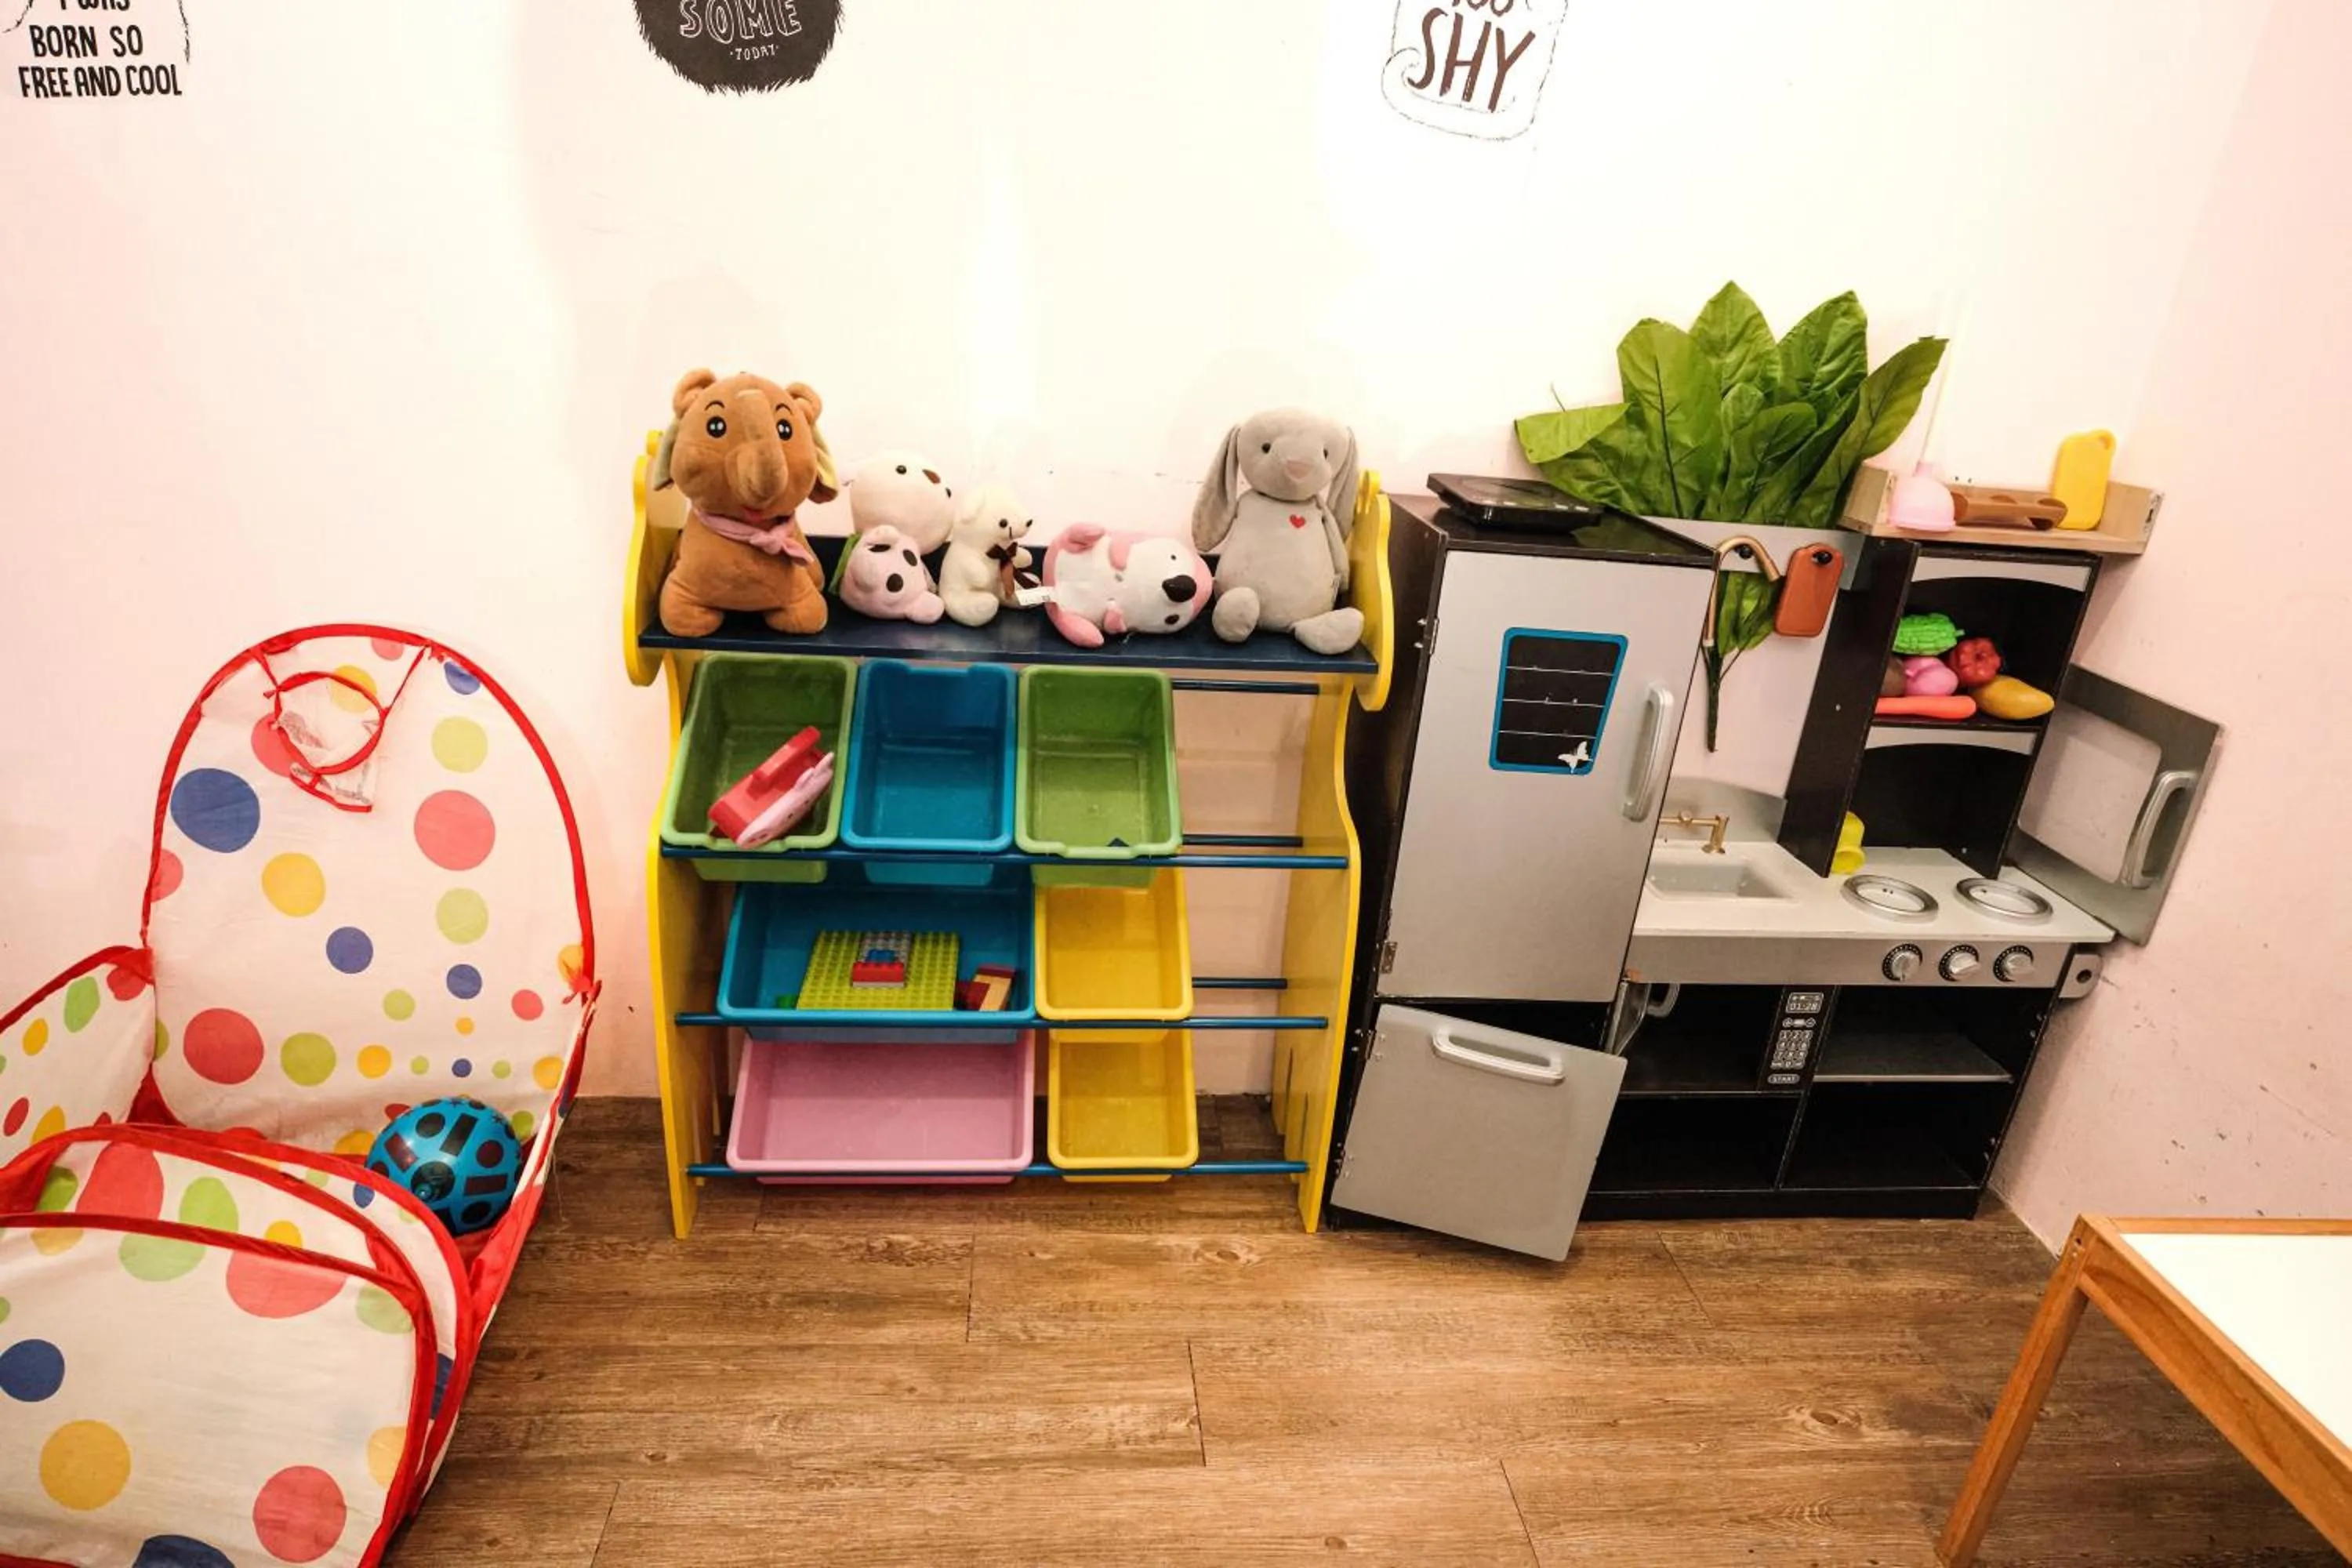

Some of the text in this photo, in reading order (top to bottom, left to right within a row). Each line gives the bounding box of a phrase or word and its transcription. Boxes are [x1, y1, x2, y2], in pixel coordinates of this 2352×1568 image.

[29, 24, 143, 58] BORN SO
[679, 0, 803, 44] SOME
[1407, 7, 1536, 113] SHY
[18, 64, 183, 99] FREE AND COOL
